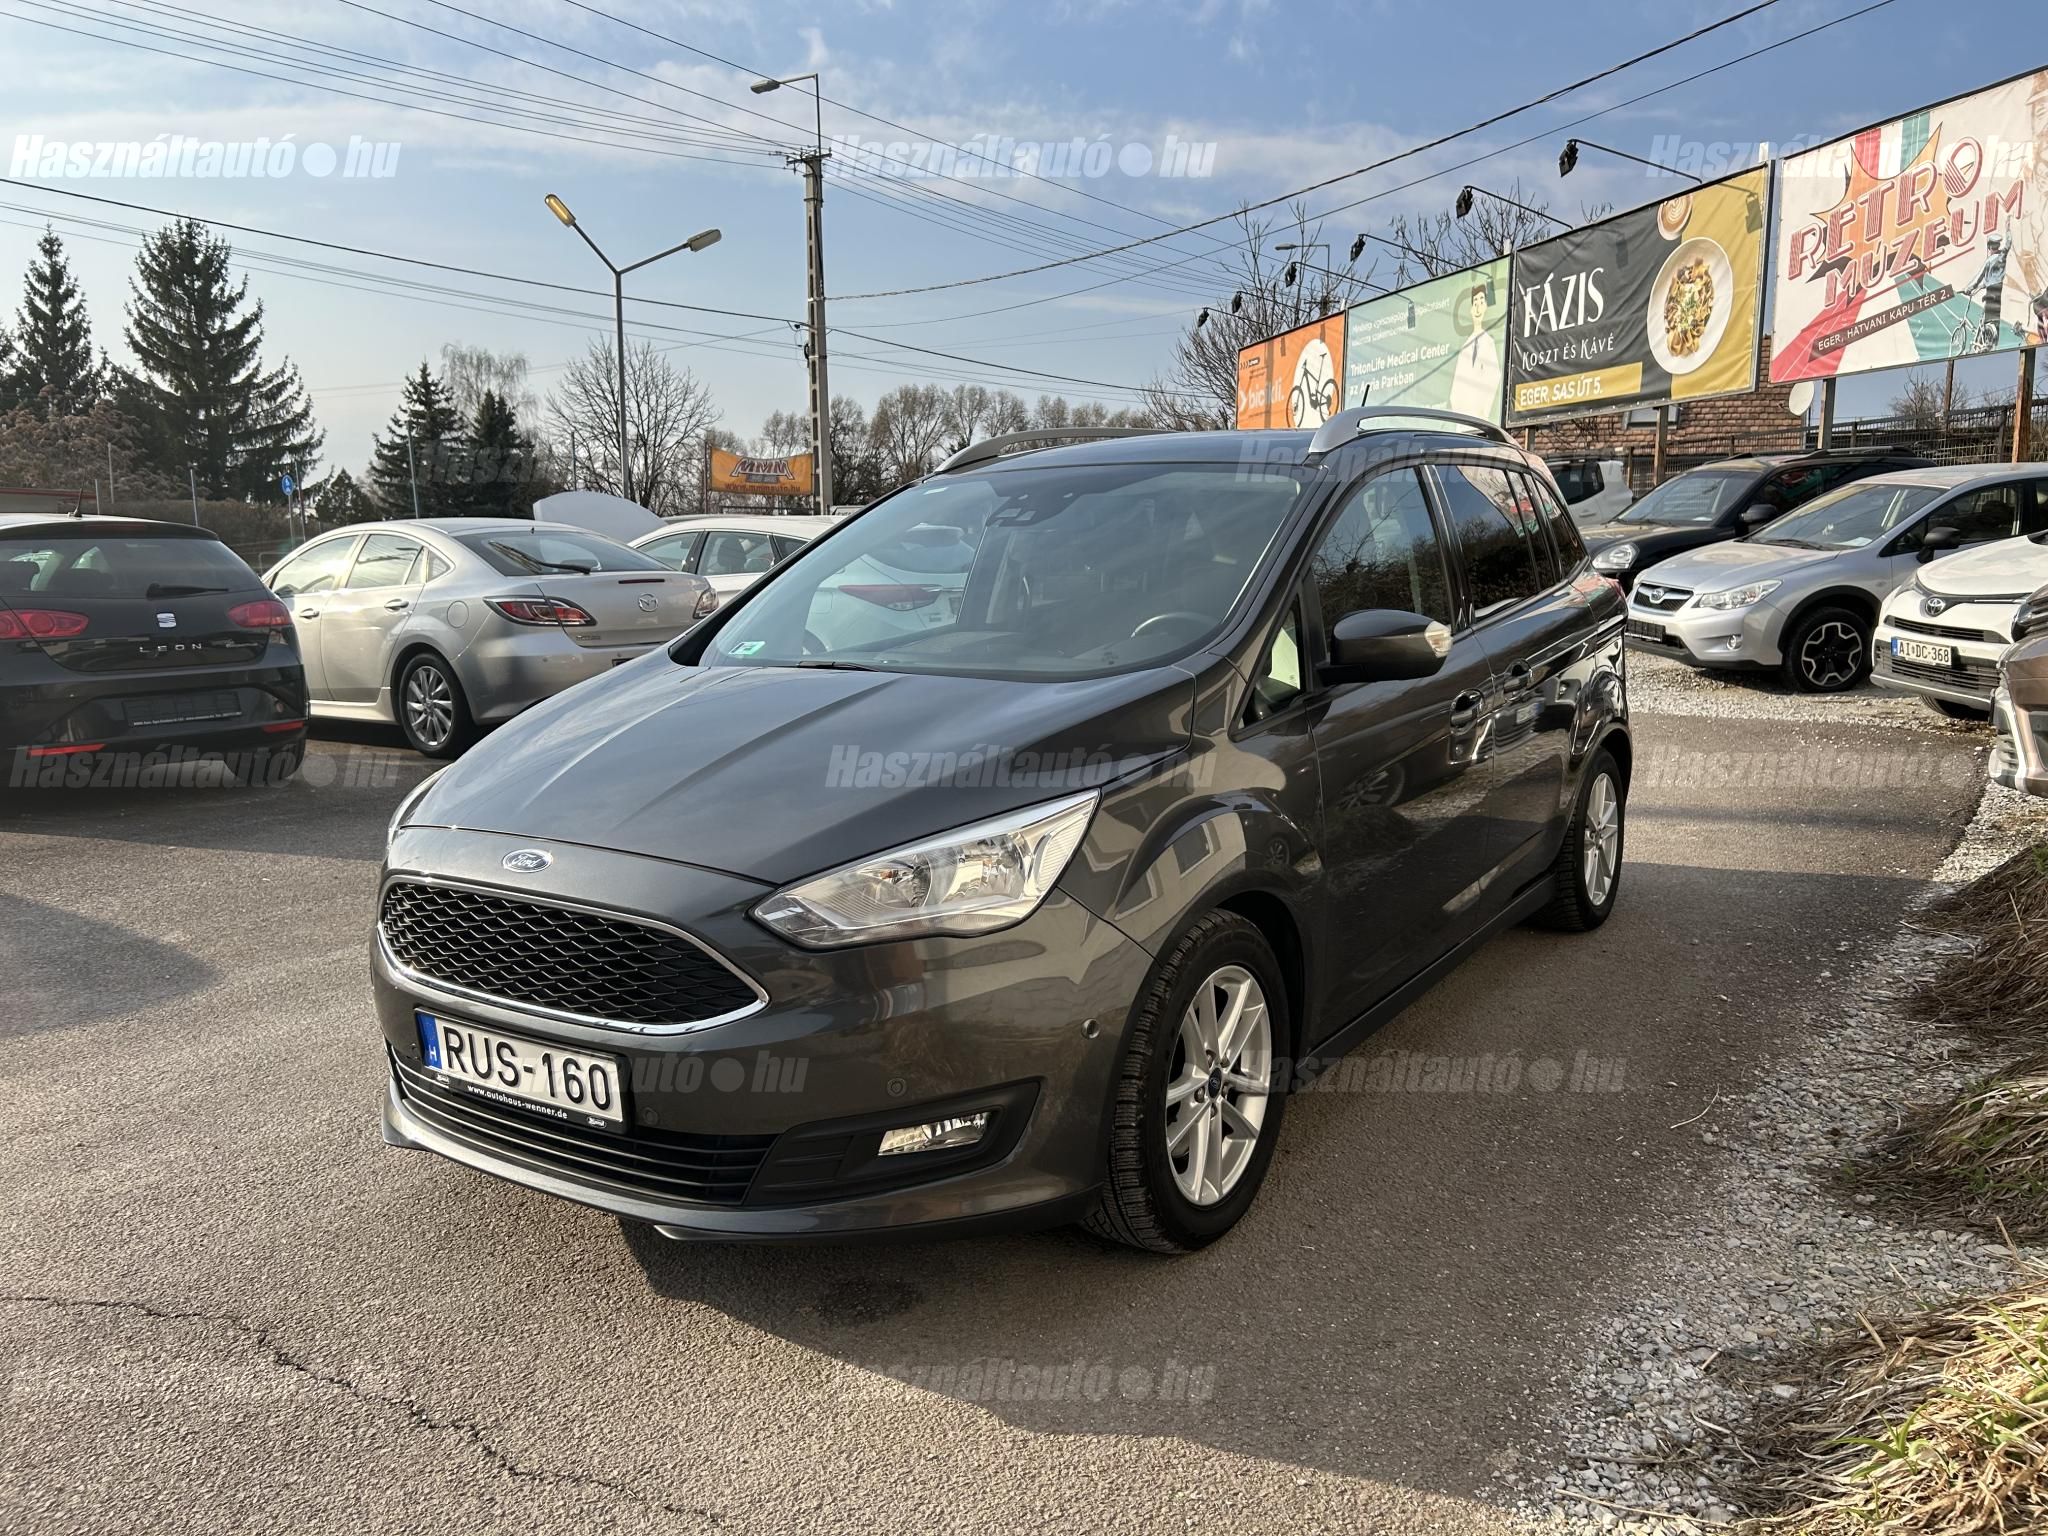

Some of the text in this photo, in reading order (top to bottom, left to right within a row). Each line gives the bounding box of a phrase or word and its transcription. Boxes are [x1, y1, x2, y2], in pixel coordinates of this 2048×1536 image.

[1788, 137, 1983, 280] RETRO
[1824, 179, 2024, 308] MÚZEUM
[1522, 267, 1604, 338] FÁZIS
[1818, 289, 1950, 351] EGER, HATVANI KAPU TÉR 2.
[1387, 349, 1418, 368] Medical
[1420, 343, 1450, 361] Center
[1522, 348, 1559, 371] KOSZT
[1381, 371, 1414, 389] Parkban
[1520, 385, 1550, 406] EGER,
[1552, 380, 1575, 401] SAS
[139, 643, 202, 653] LEON
[428, 1045, 437, 1061] H
[443, 1026, 610, 1111] RUS-160
[467, 1084, 568, 1119] www.autohaus-wenner.de
